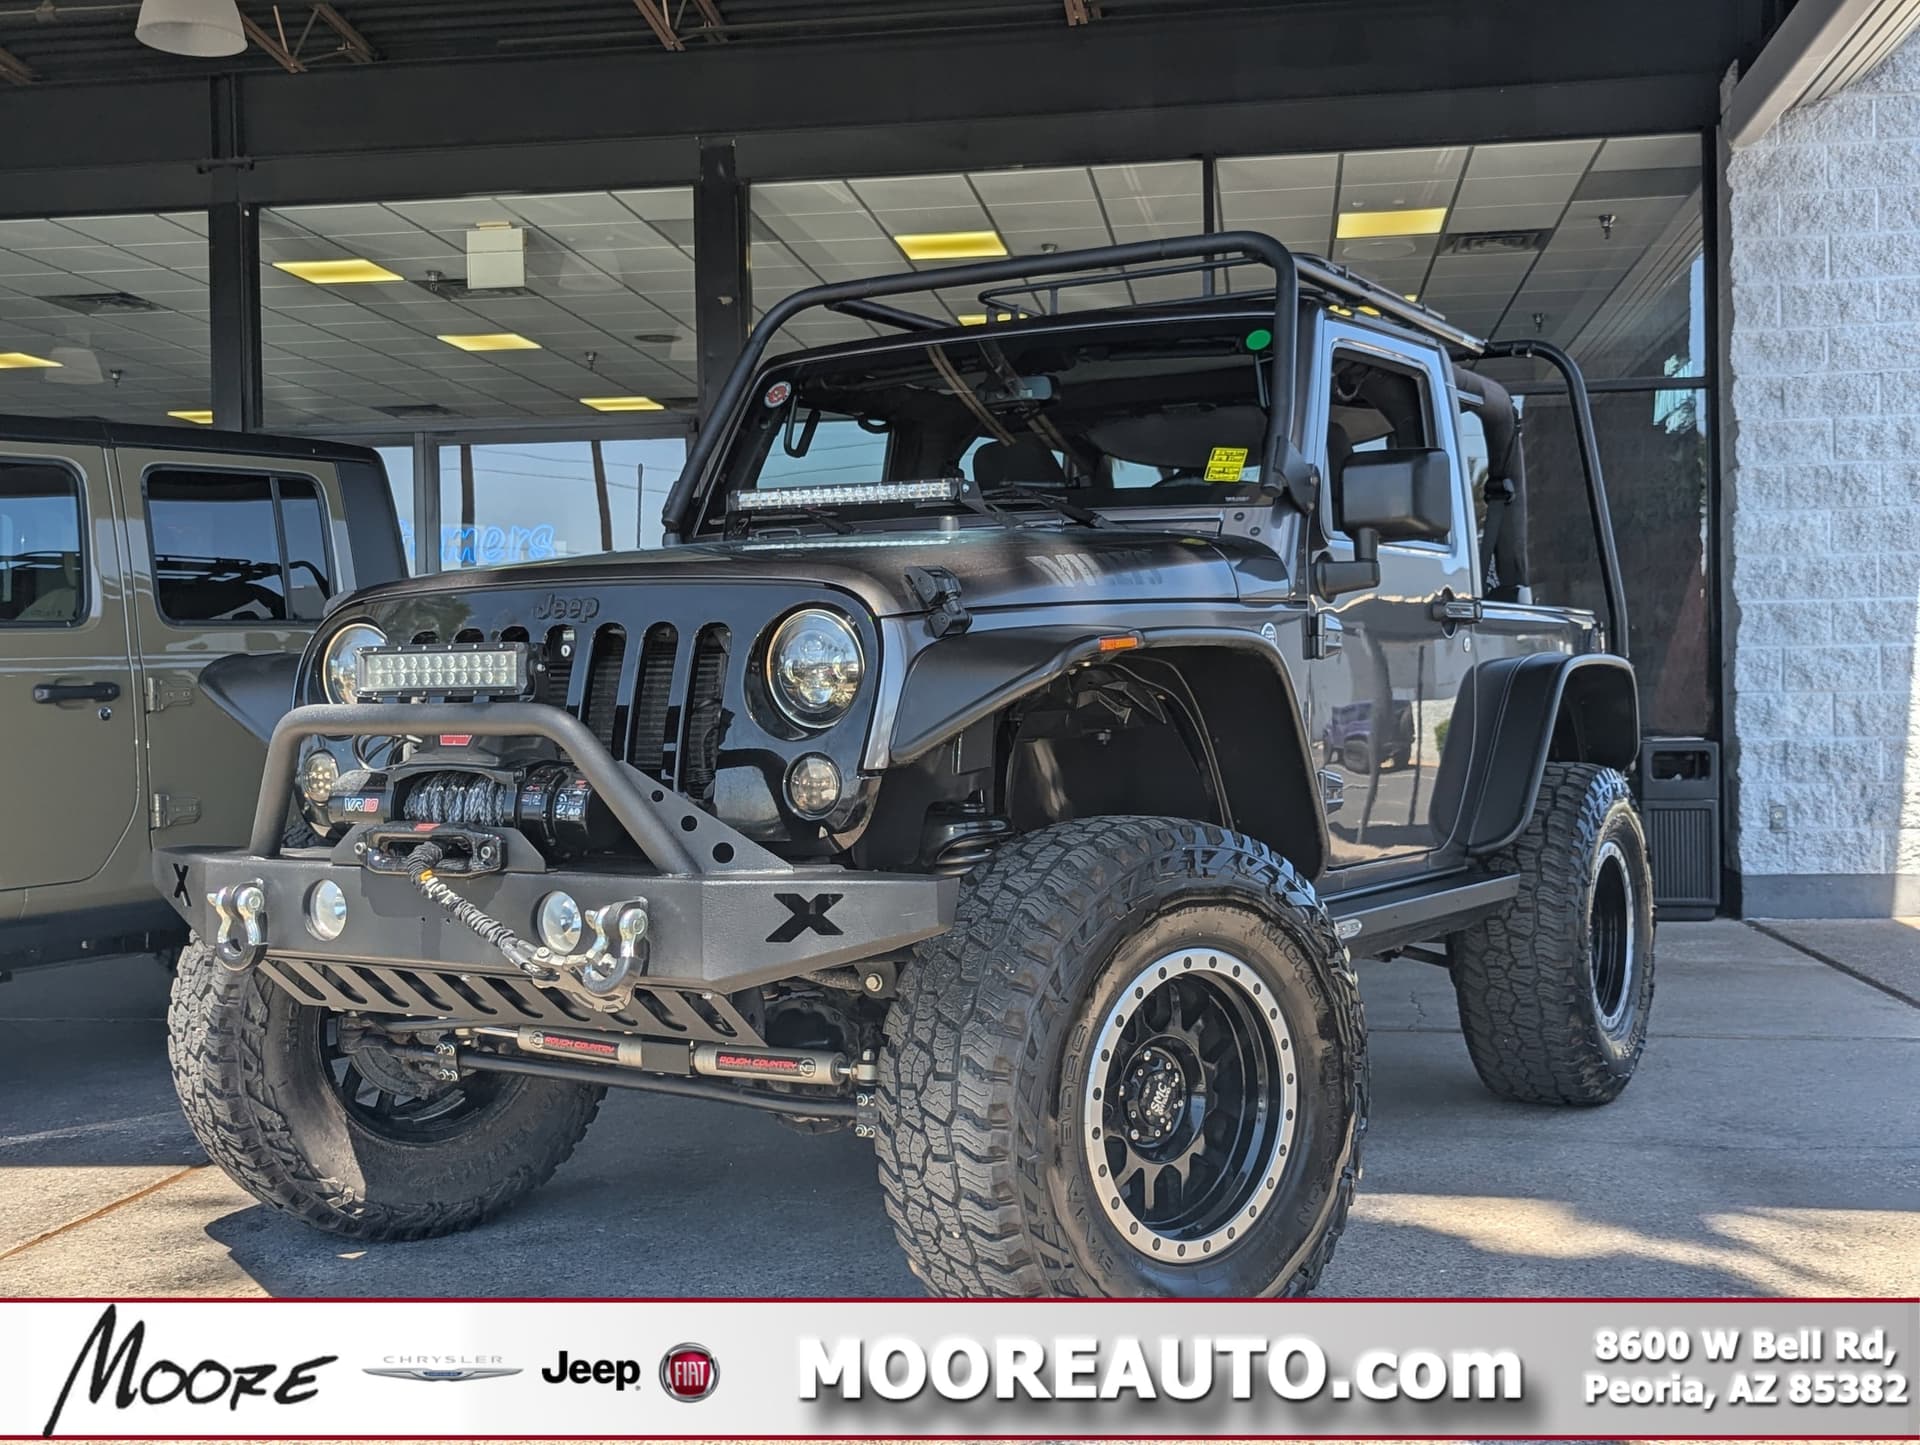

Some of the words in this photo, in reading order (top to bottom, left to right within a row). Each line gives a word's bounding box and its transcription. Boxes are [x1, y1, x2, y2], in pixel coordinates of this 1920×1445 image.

[536, 593, 600, 622] Jeep
[544, 1035, 574, 1048] ROUGH
[574, 1040, 615, 1054] COUNTRY
[719, 1055, 751, 1066] ROUGH
[752, 1058, 798, 1069] COUNTRY
